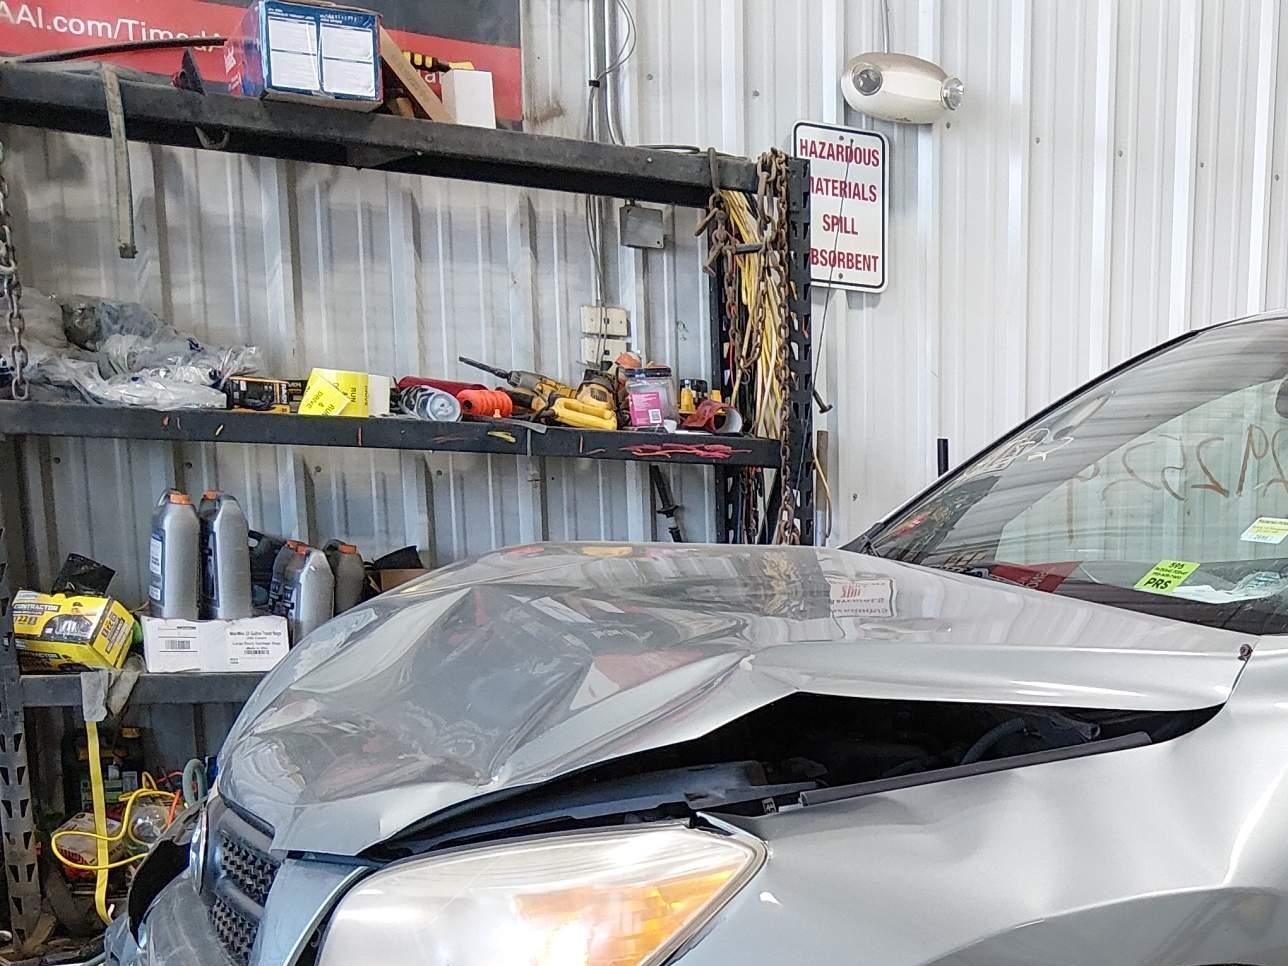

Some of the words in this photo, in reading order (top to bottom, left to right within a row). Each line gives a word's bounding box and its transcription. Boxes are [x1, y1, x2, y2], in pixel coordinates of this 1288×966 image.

[800, 138, 879, 167] HAZARDOUS
[822, 214, 858, 235] SPILL
[1144, 577, 1172, 590] PRS
